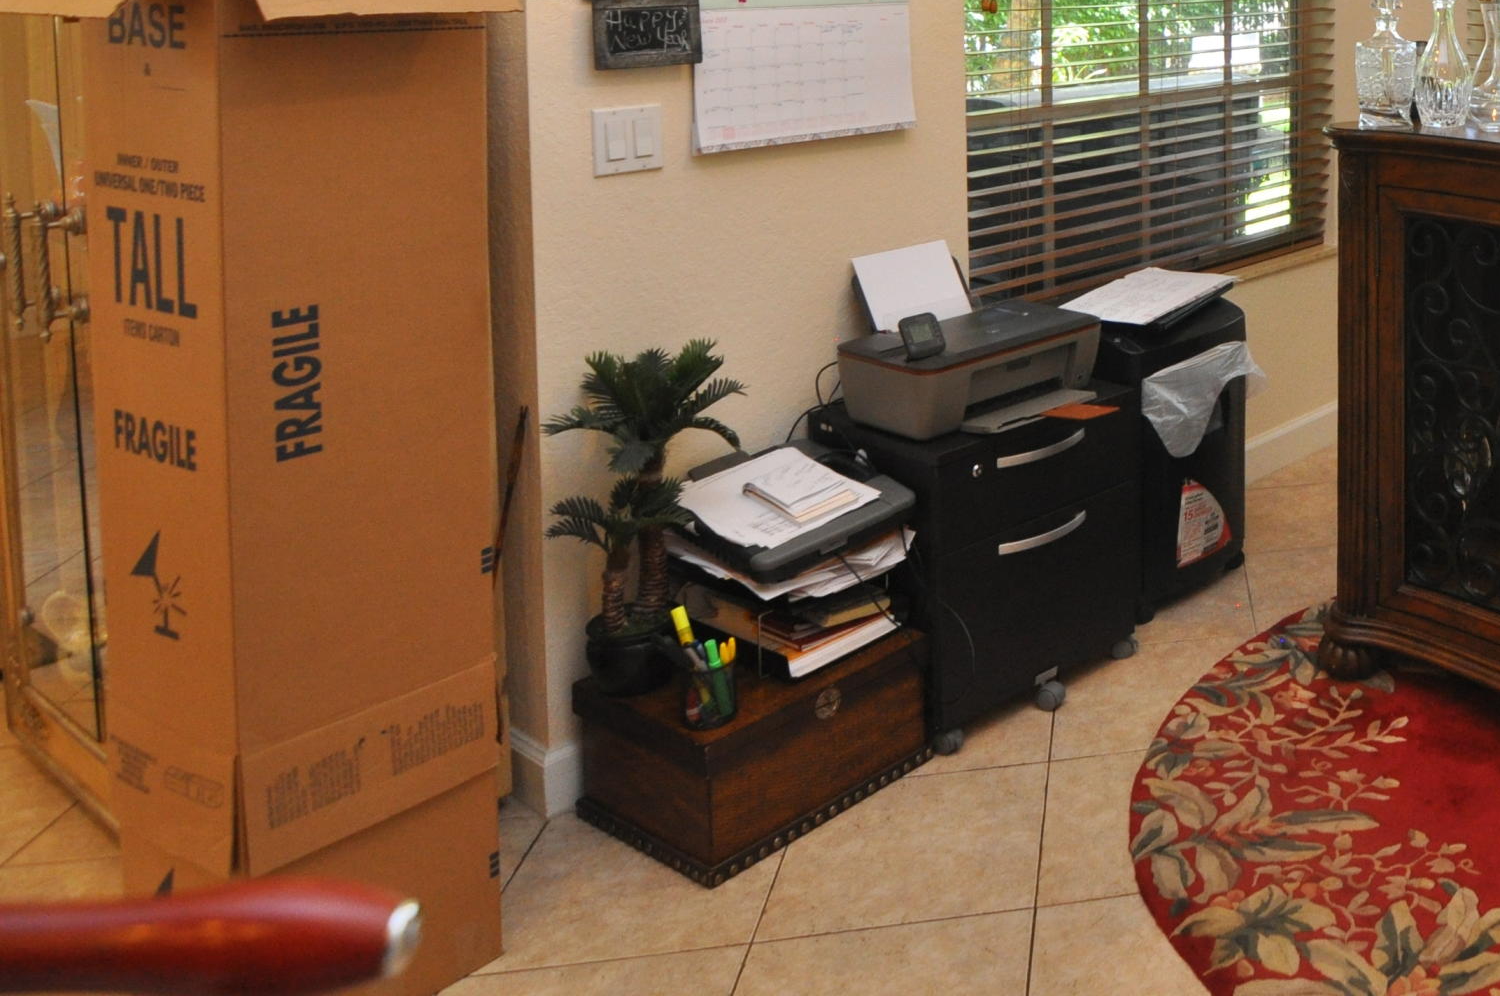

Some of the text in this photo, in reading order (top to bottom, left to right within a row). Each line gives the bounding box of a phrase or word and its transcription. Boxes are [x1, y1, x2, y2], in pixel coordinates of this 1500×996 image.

[108, 3, 187, 50] BASE
[94, 170, 138, 192] UNIVERSAL
[180, 182, 206, 203] PIECE
[150, 157, 179, 174] OUTER
[106, 206, 197, 319] TALL
[271, 304, 323, 462] FRAGILE
[114, 408, 197, 472] FRAGILE
